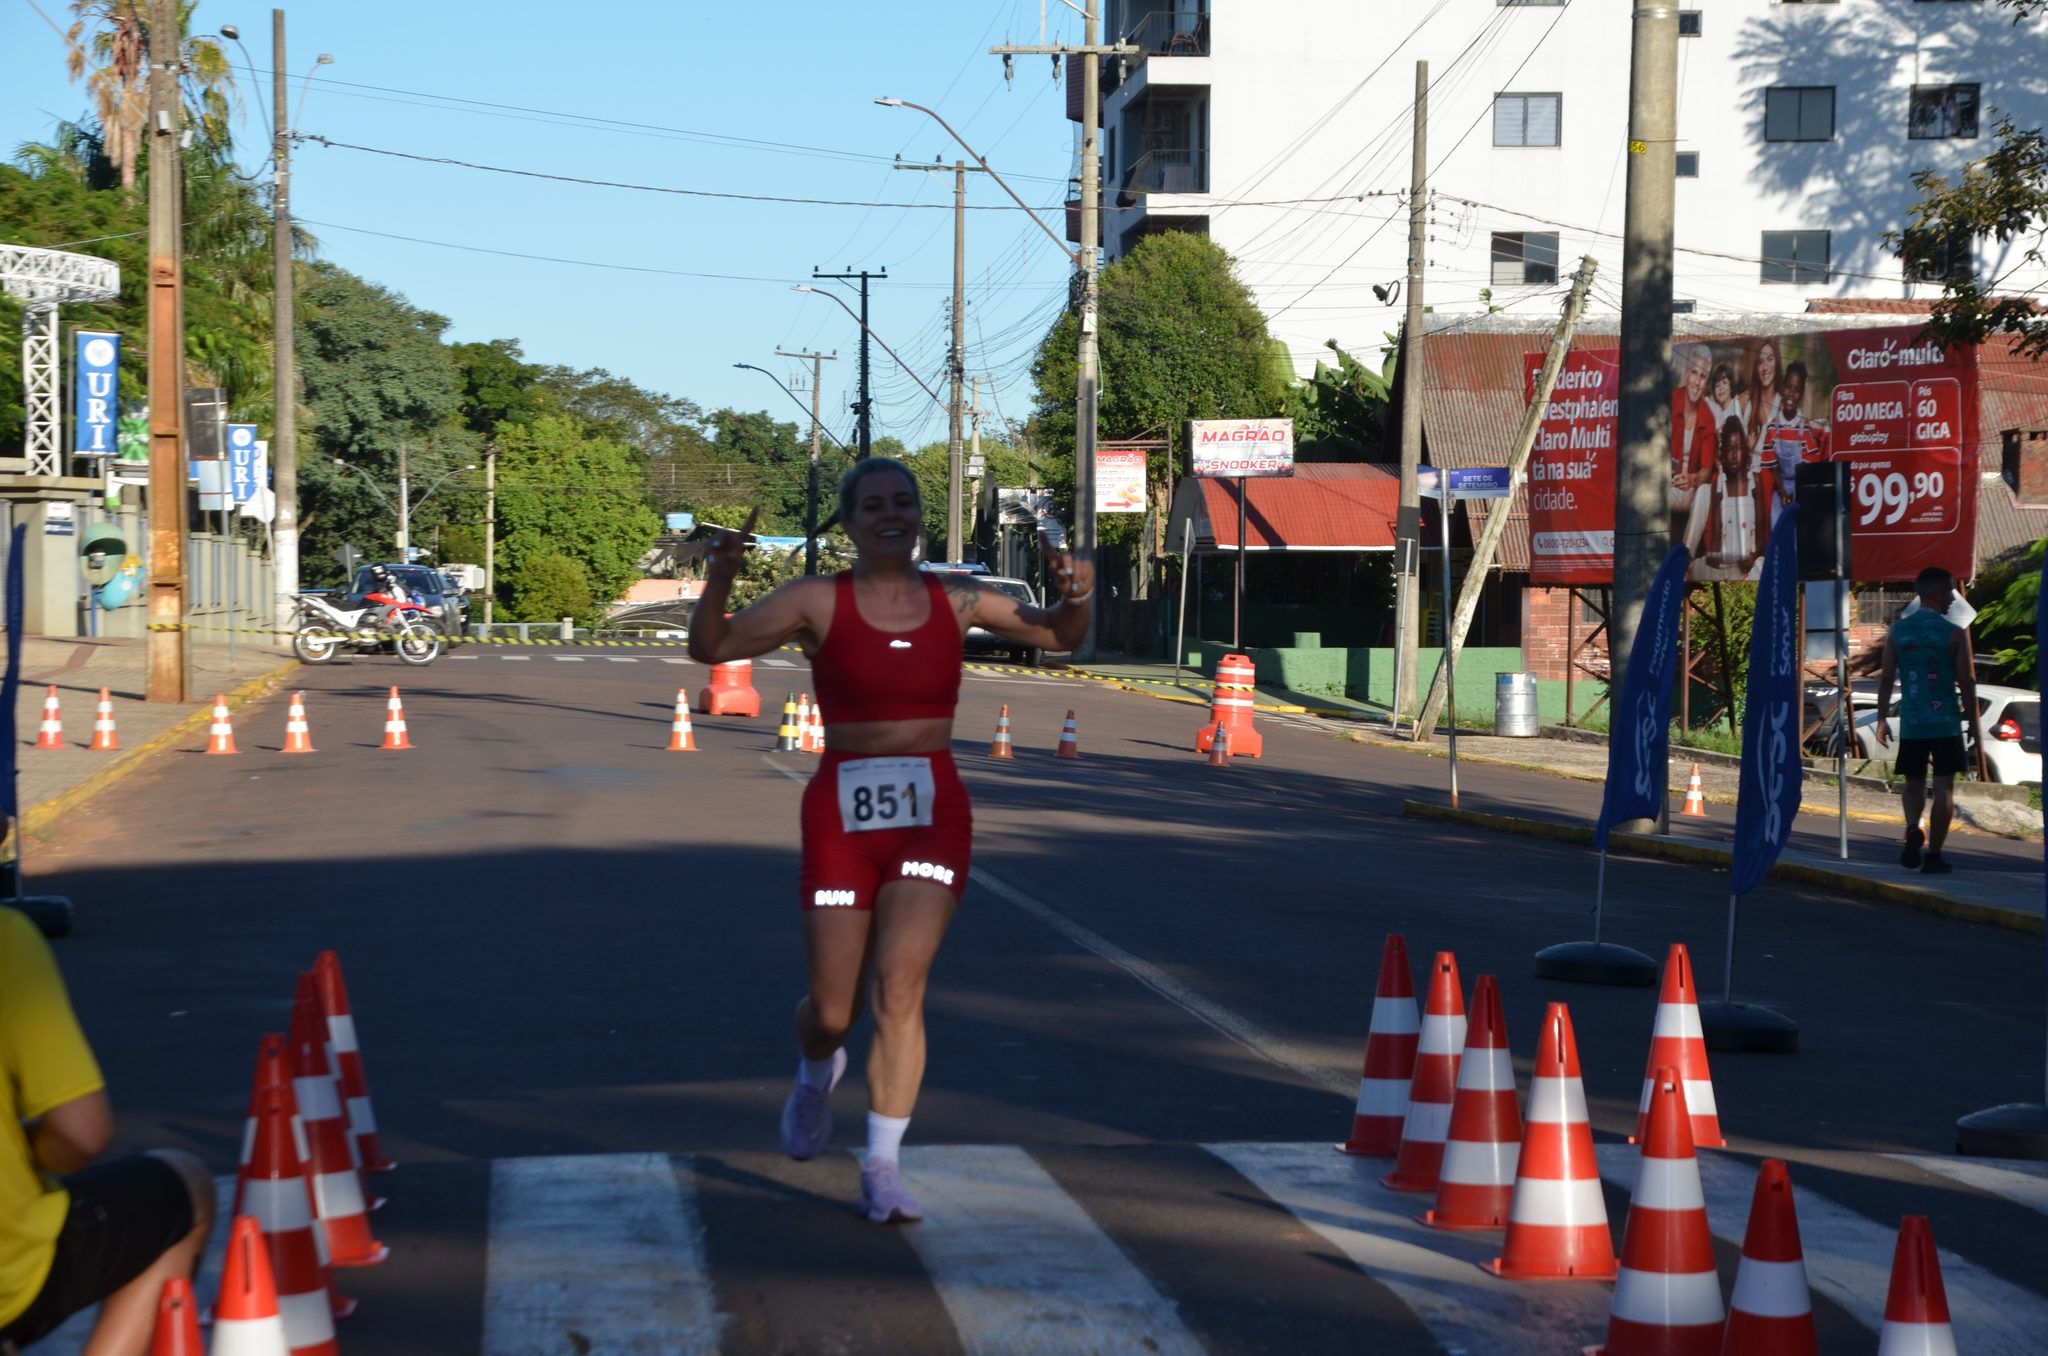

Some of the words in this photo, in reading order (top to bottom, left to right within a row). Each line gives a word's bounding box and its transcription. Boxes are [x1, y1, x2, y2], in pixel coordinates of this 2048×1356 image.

[1837, 390, 1855, 401] Fibra
[1917, 386, 1932, 396] Pós
[86, 372, 112, 449] URI
[1542, 394, 1619, 425] estphalen
[1837, 403, 1863, 421] 600
[1864, 401, 1904, 420] MEGA
[1917, 399, 1937, 418] 60
[1202, 426, 1285, 443] MAGRÃO
[1533, 427, 1568, 451] Claro
[1569, 424, 1611, 449] Multi
[1916, 422, 1951, 440] GIGA
[1096, 454, 1143, 464] MAGRÃO
[1210, 460, 1278, 470] SNOOKER
[1532, 456, 1546, 481] tá
[1547, 462, 1565, 480] na
[1566, 460, 1592, 480] sua
[233, 449, 252, 499] URI
[1533, 486, 1578, 511] cidade.
[1858, 471, 1945, 526] 99,90
[853, 782, 918, 822] 851
[901, 861, 954, 885] MORE
[814, 890, 856, 906] RUN
